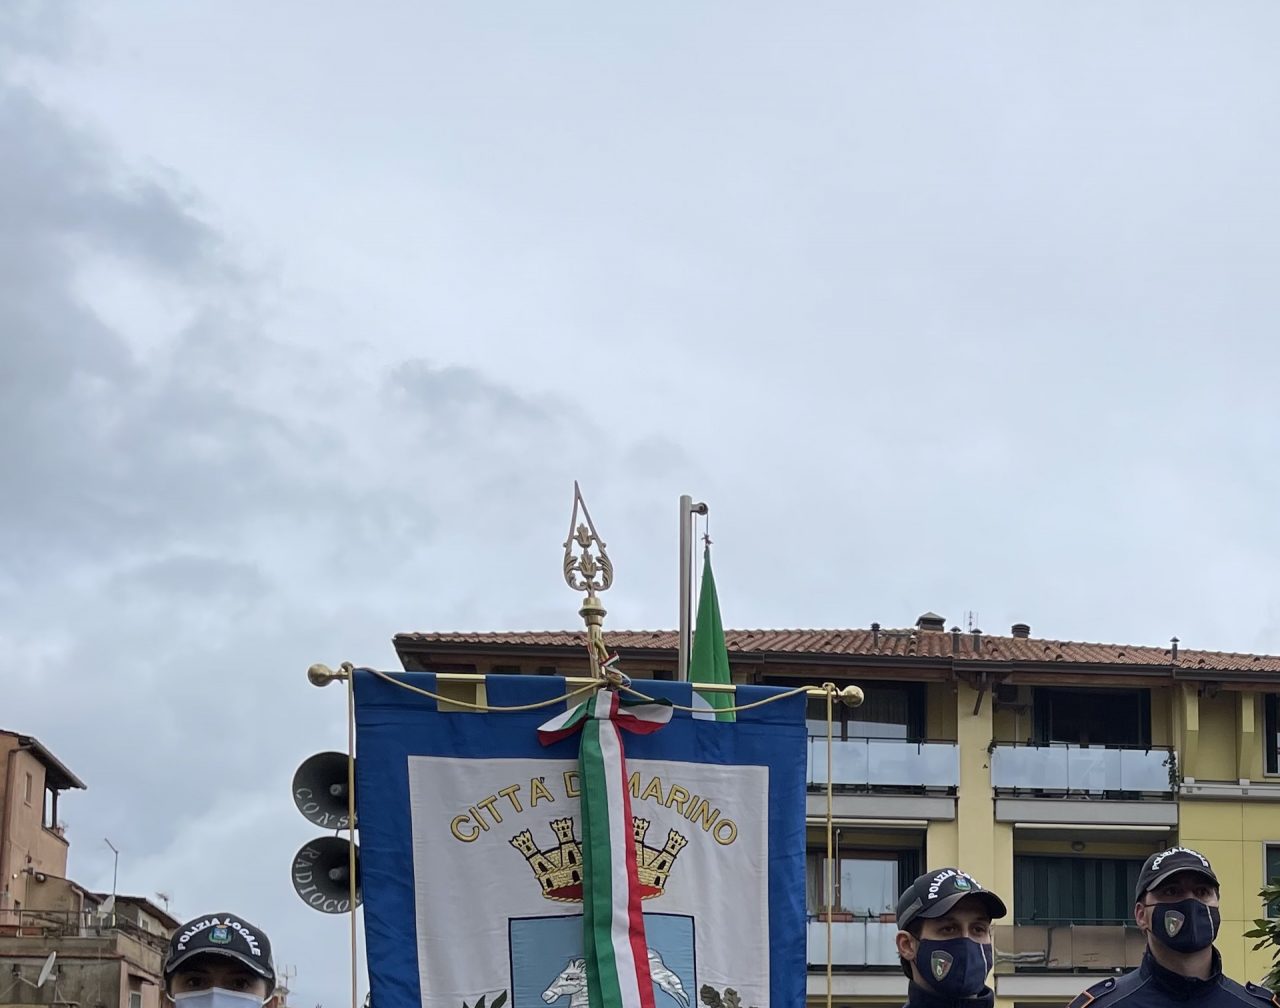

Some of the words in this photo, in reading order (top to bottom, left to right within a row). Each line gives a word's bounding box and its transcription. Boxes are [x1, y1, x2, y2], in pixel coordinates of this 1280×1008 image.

[928, 869, 957, 900] POLIZIA
[177, 917, 221, 951] POLIZIA
[223, 917, 261, 957] LOCALE
